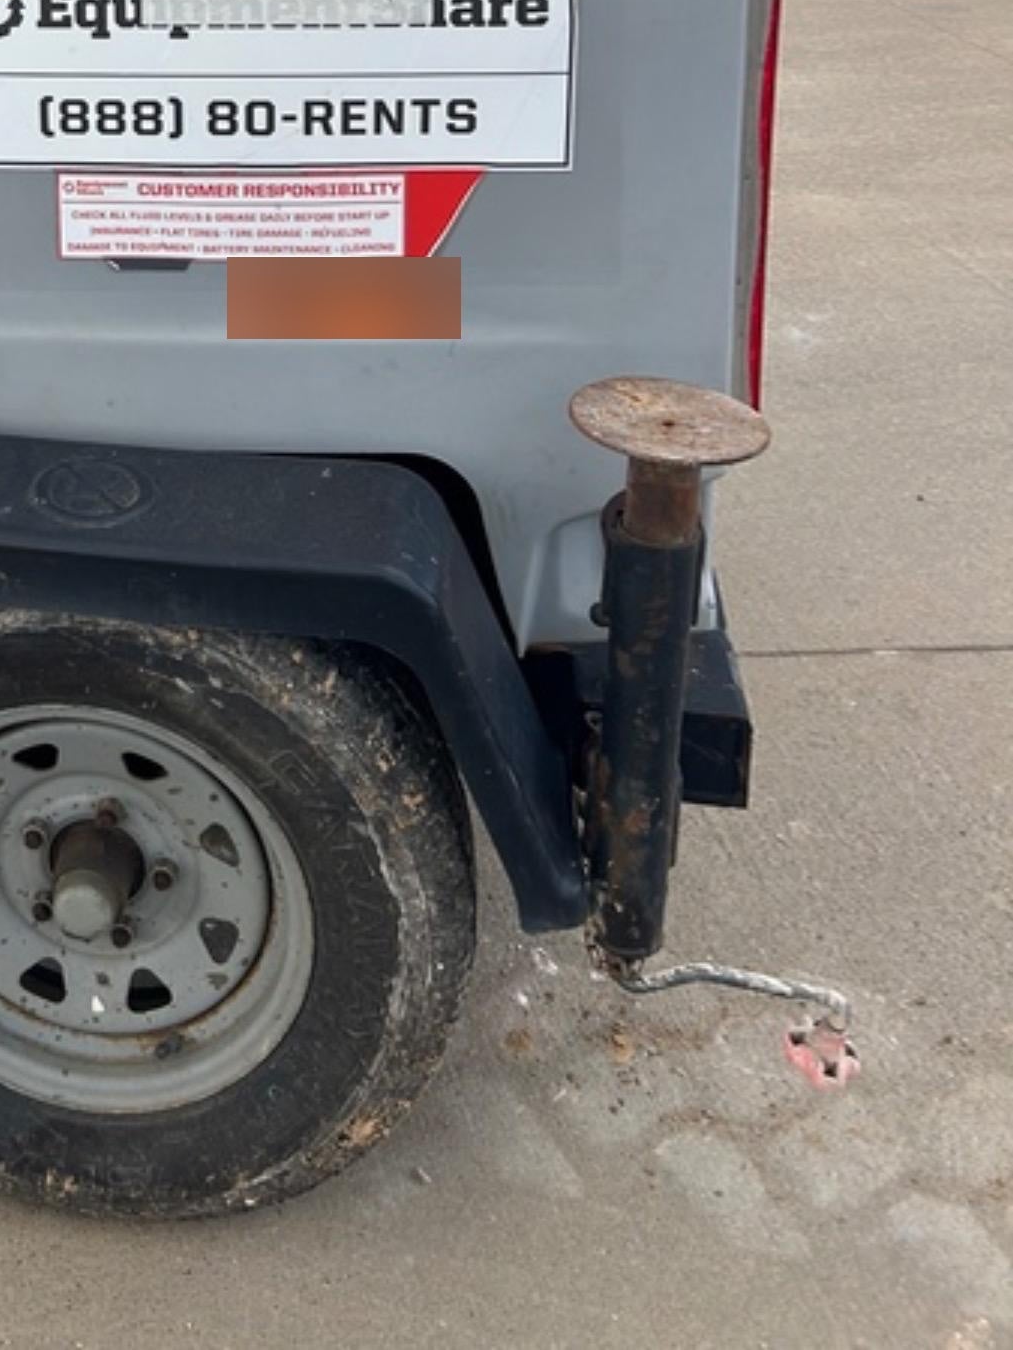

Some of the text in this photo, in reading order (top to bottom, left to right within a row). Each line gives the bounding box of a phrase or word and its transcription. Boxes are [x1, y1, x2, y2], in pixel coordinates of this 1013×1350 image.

[40, 96, 478, 139] (888) 80-RENTS
[136, 181, 402, 198] CUSTOMER RESPONSIBILITY
[71, 209, 106, 220] CHECK
[109, 210, 126, 220] ALL
[163, 211, 202, 222] LEVELS
[215, 212, 256, 222] GREASE
[260, 212, 290, 222] DAILY
[293, 212, 334, 222] BEFORE
[338, 211, 372, 222] START
[374, 211, 390, 220] UP
[90, 227, 151, 236] INSURANCE
[160, 227, 185, 237] FLAT
